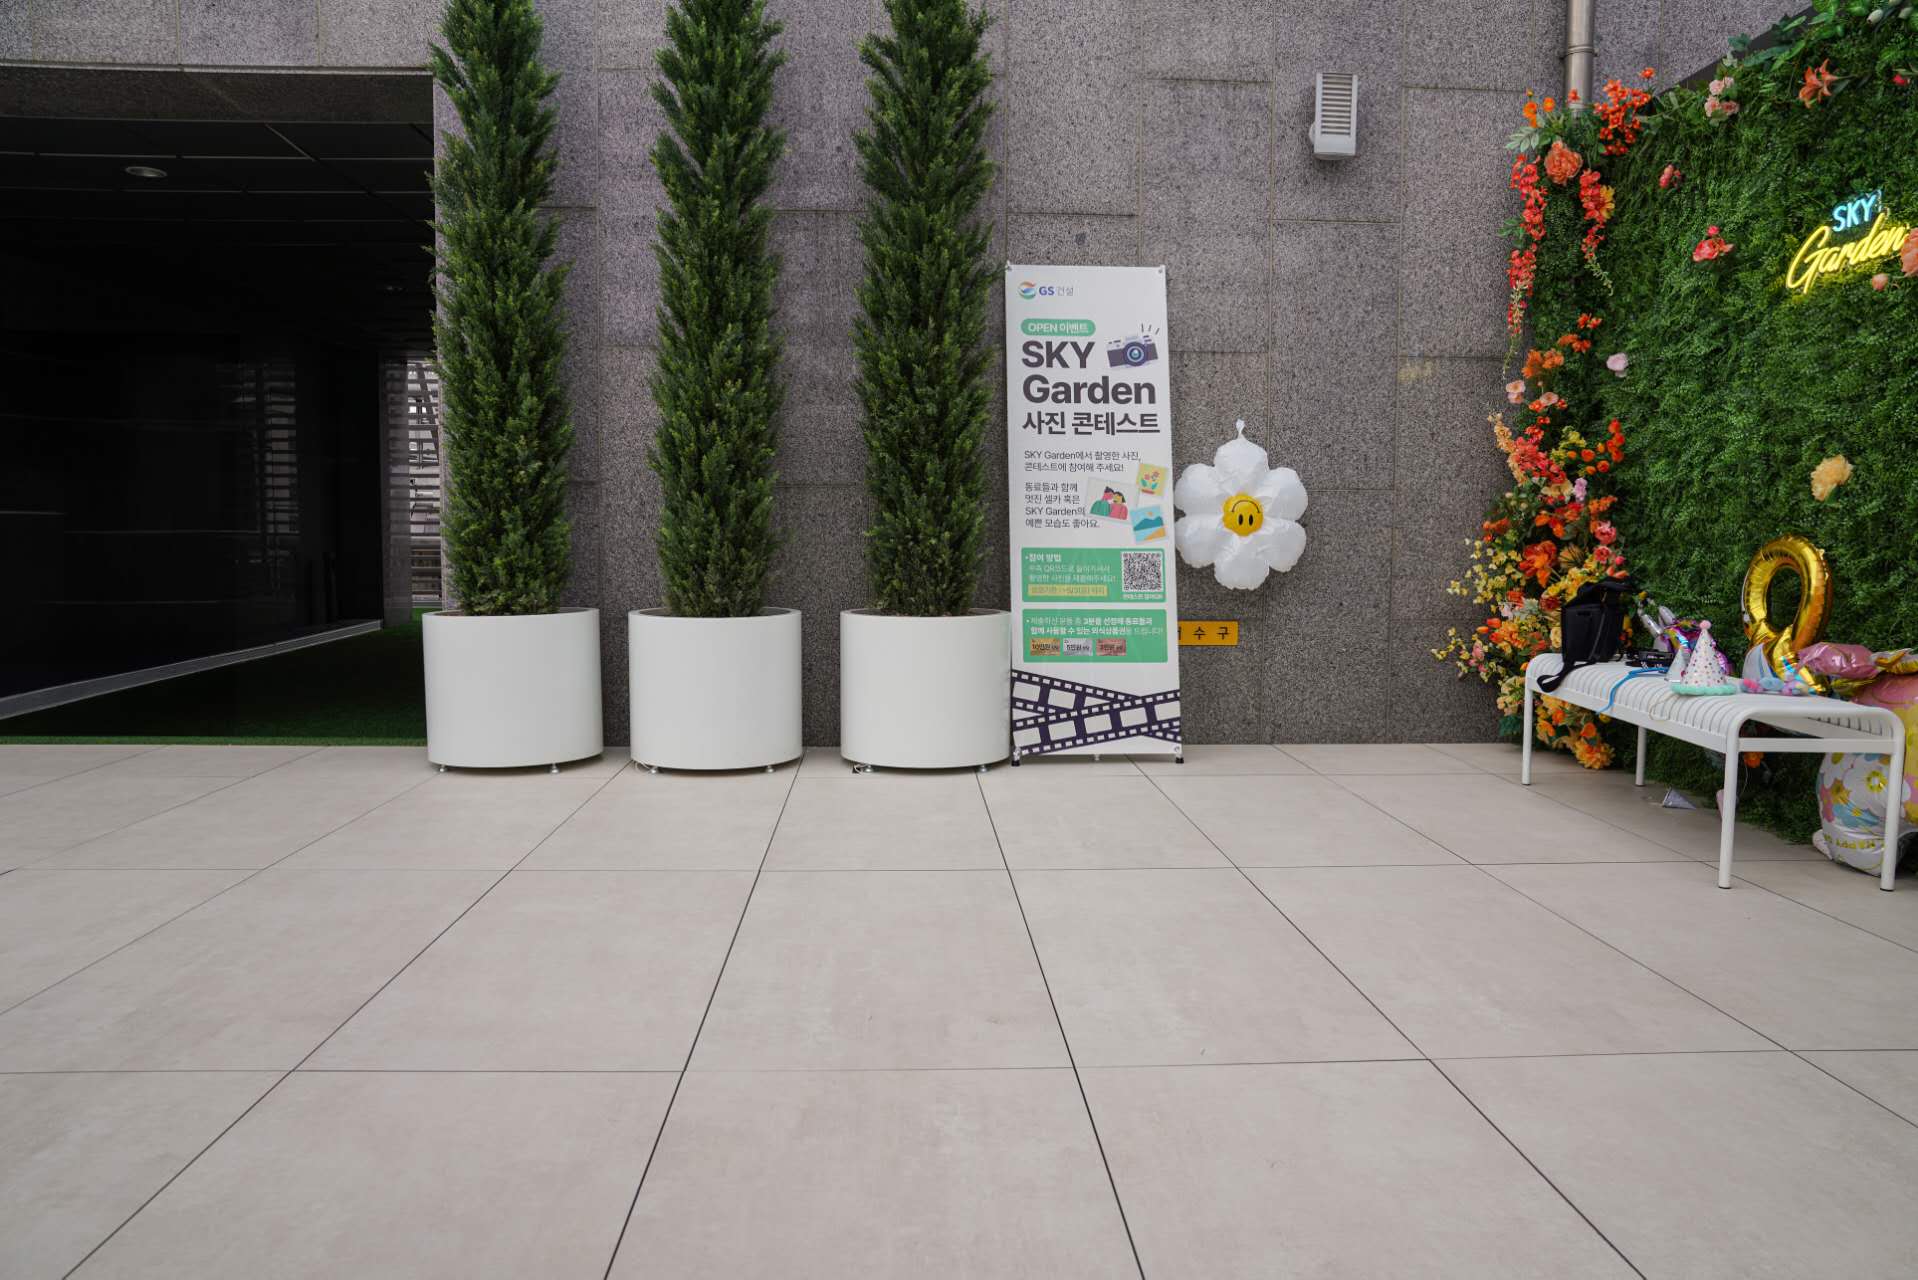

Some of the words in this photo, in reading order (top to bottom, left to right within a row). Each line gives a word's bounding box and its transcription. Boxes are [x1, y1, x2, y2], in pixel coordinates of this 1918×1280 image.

[1832, 193, 1878, 232] SKY
[1786, 212, 1910, 294] Garden
[1039, 286, 1055, 296] GS
[1057, 285, 1074, 297] 건설
[1028, 323, 1058, 332] OPEN
[1059, 322, 1089, 334] 이벤트
[1022, 339, 1095, 369] SKY
[1022, 374, 1156, 405] Garden
[1022, 411, 1066, 435] 사진
[1072, 411, 1160, 436] 콘테스트
[1024, 450, 1042, 460] SKY
[1044, 450, 1093, 460] Garden에서
[1095, 450, 1120, 461] 촬영한
[1024, 462, 1067, 472] 콘테스트에
[1069, 462, 1095, 473] 참여해
[1096, 463, 1124, 473] 주세요!
[1025, 482, 1059, 492] 동료들과
[1061, 482, 1078, 493] 함께
[1025, 494, 1042, 505] 멋진
[1045, 494, 1061, 505] 셀카
[1063, 494, 1081, 505] 혹은
[1025, 507, 1043, 516] SKY
[1045, 506, 1086, 517] Garden의
[1025, 519, 1042, 529] 예쁜
[1045, 519, 1070, 529] 모습도
[1072, 518, 1099, 528] 좋아요.
